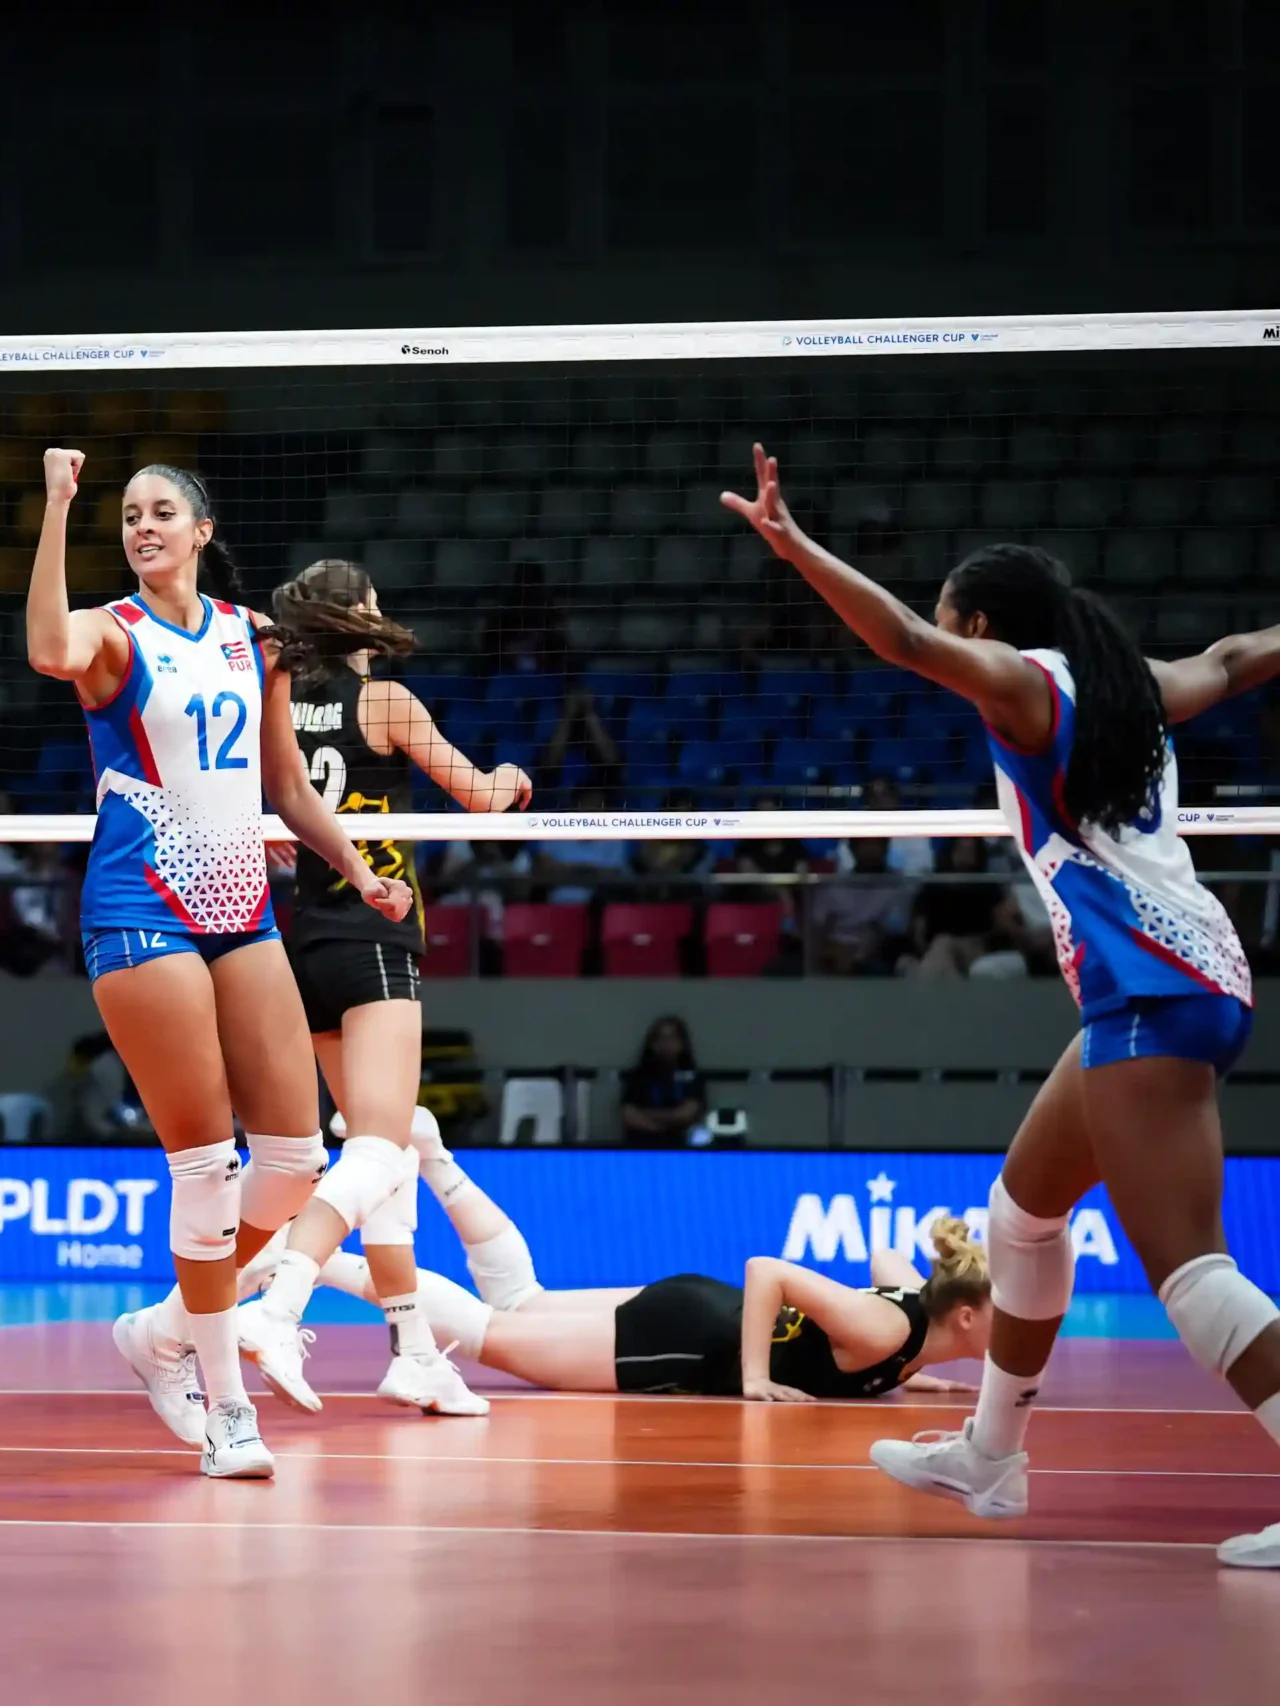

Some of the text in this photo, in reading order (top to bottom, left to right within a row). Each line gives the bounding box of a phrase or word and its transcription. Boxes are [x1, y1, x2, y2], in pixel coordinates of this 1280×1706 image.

[796, 333, 965, 345] VOLLEYBALL CHALLENGER CUP
[43, 351, 110, 360] CHALLENGER
[114, 350, 135, 359] CUP
[412, 346, 449, 355] Senoh
[228, 660, 253, 672] PUR
[184, 691, 248, 771] 12
[542, 818, 708, 827] VOLLEYBALL CHALLENGER CUP
[1177, 813, 1200, 822] CUP
[782, 1171, 1120, 1265] MiKA
[57, 1240, 144, 1269] Home
